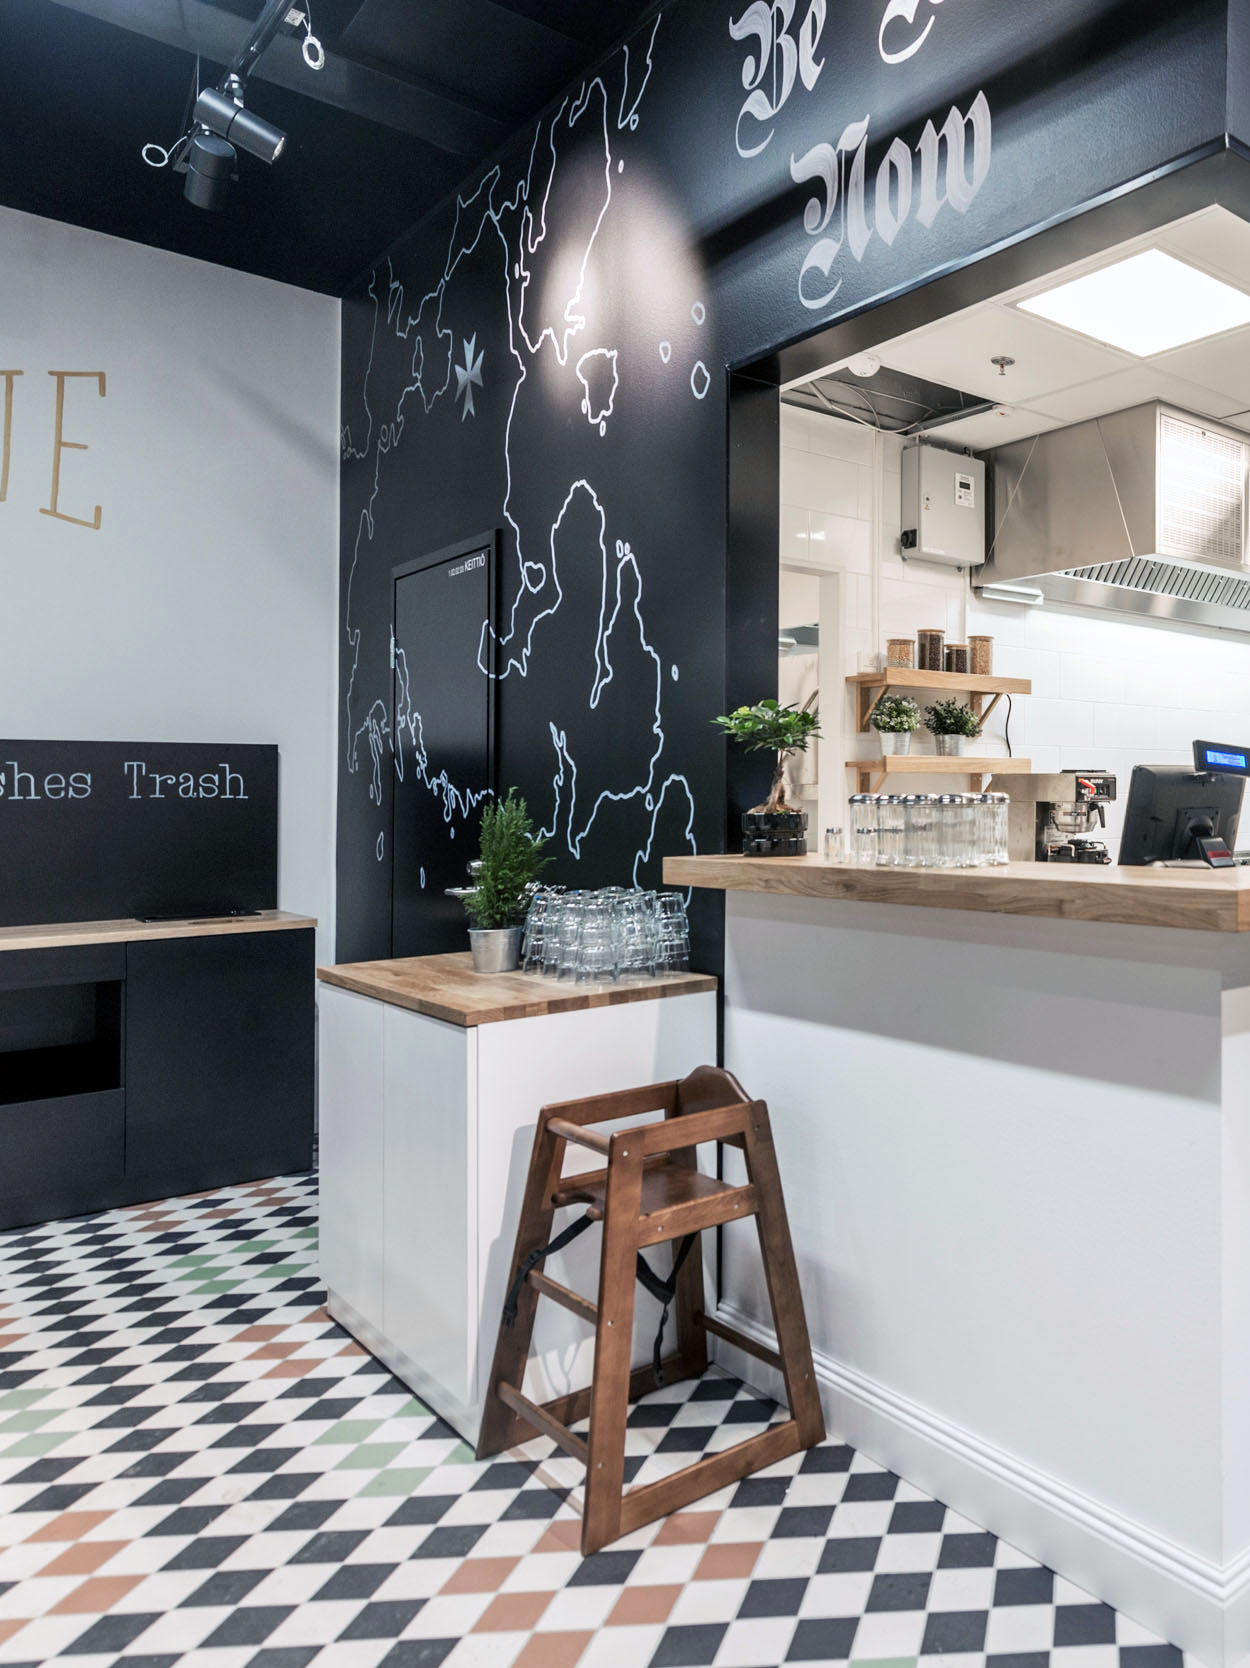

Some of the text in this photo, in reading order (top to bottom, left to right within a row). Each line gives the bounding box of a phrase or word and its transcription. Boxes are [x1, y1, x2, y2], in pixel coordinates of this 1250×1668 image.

[728, 0, 827, 158] Be
[789, 89, 992, 310] Now
[124, 761, 249, 799] Trash
